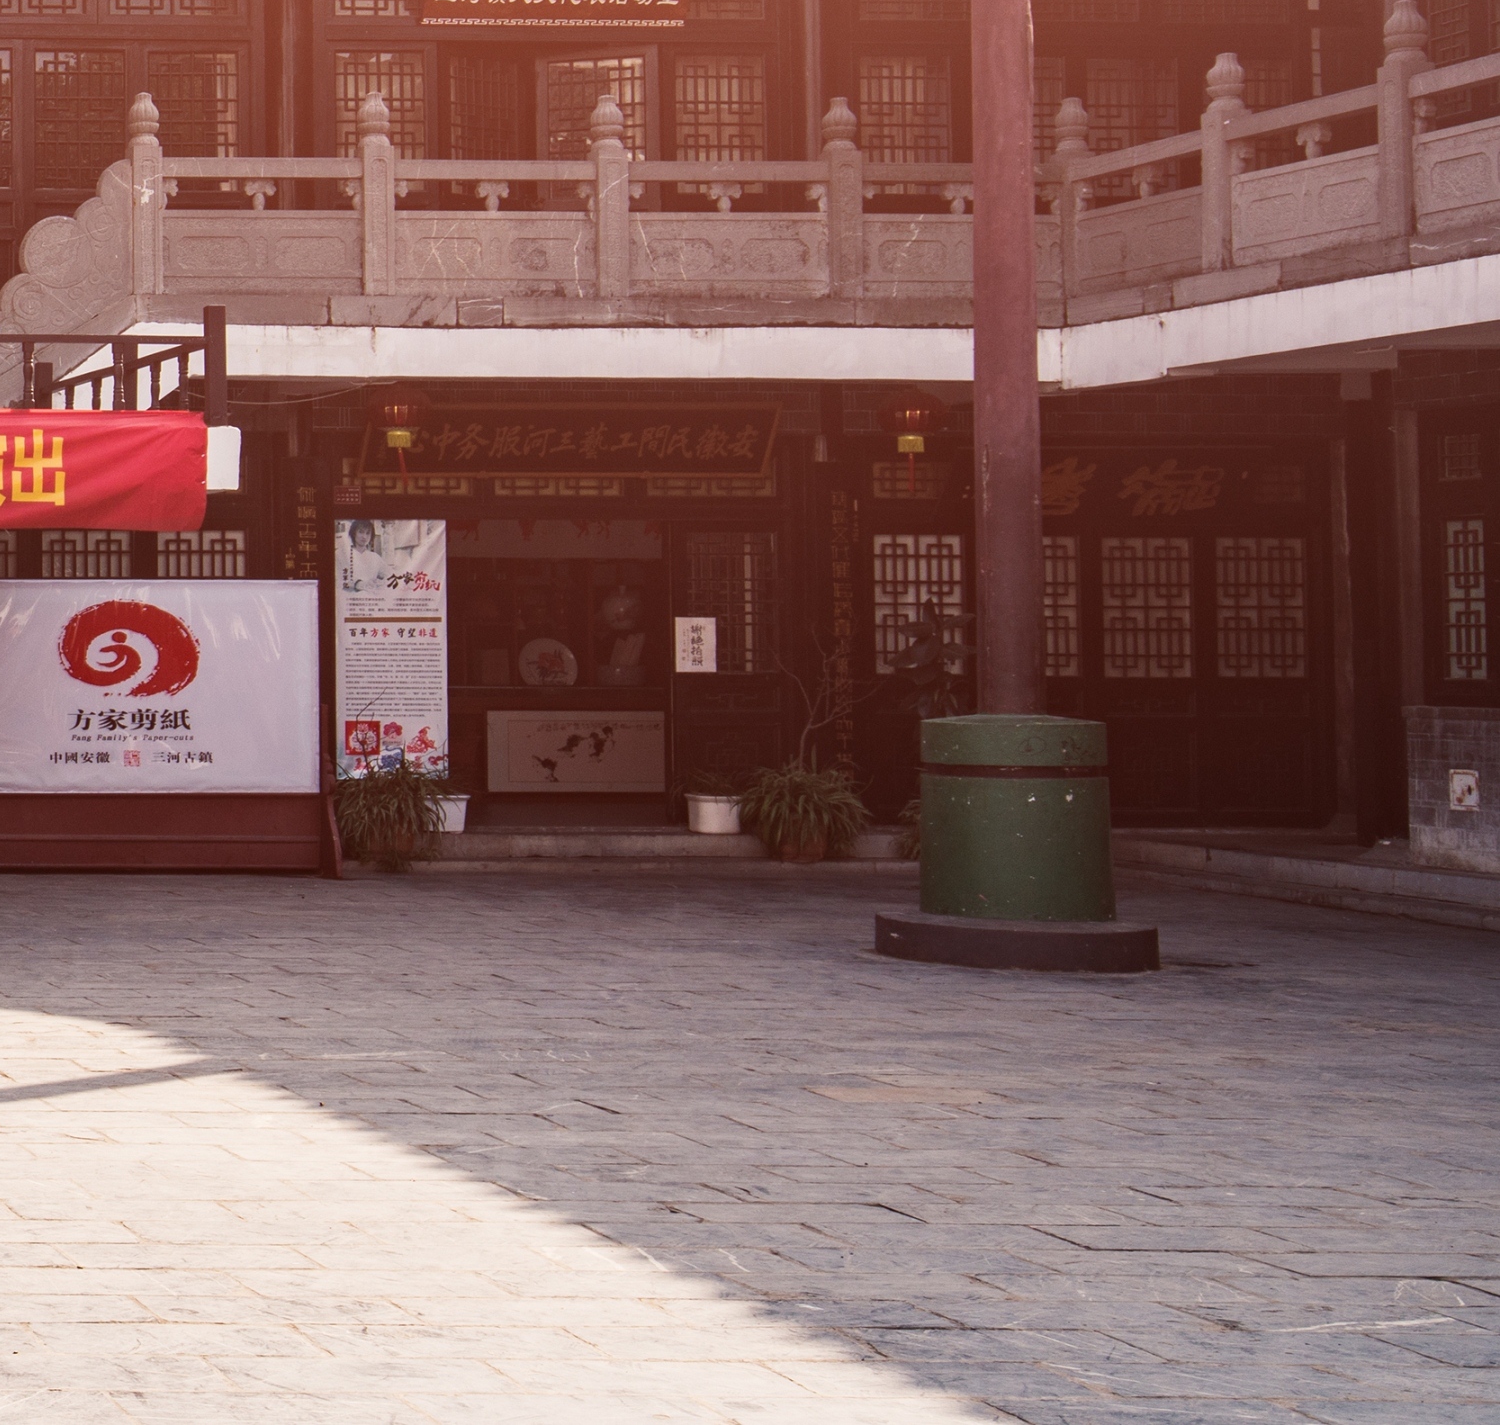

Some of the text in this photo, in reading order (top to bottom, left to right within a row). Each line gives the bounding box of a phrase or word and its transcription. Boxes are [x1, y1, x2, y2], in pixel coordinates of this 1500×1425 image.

[348, 627, 439, 639] 百年方家 守望非遗
[67, 708, 192, 731] 方家剪紙
[71, 733, 92, 742] Fang
[142, 733, 194, 742] Paper-cuts
[49, 750, 111, 764] 中國安徽
[151, 750, 214, 764] 三河古鎮
